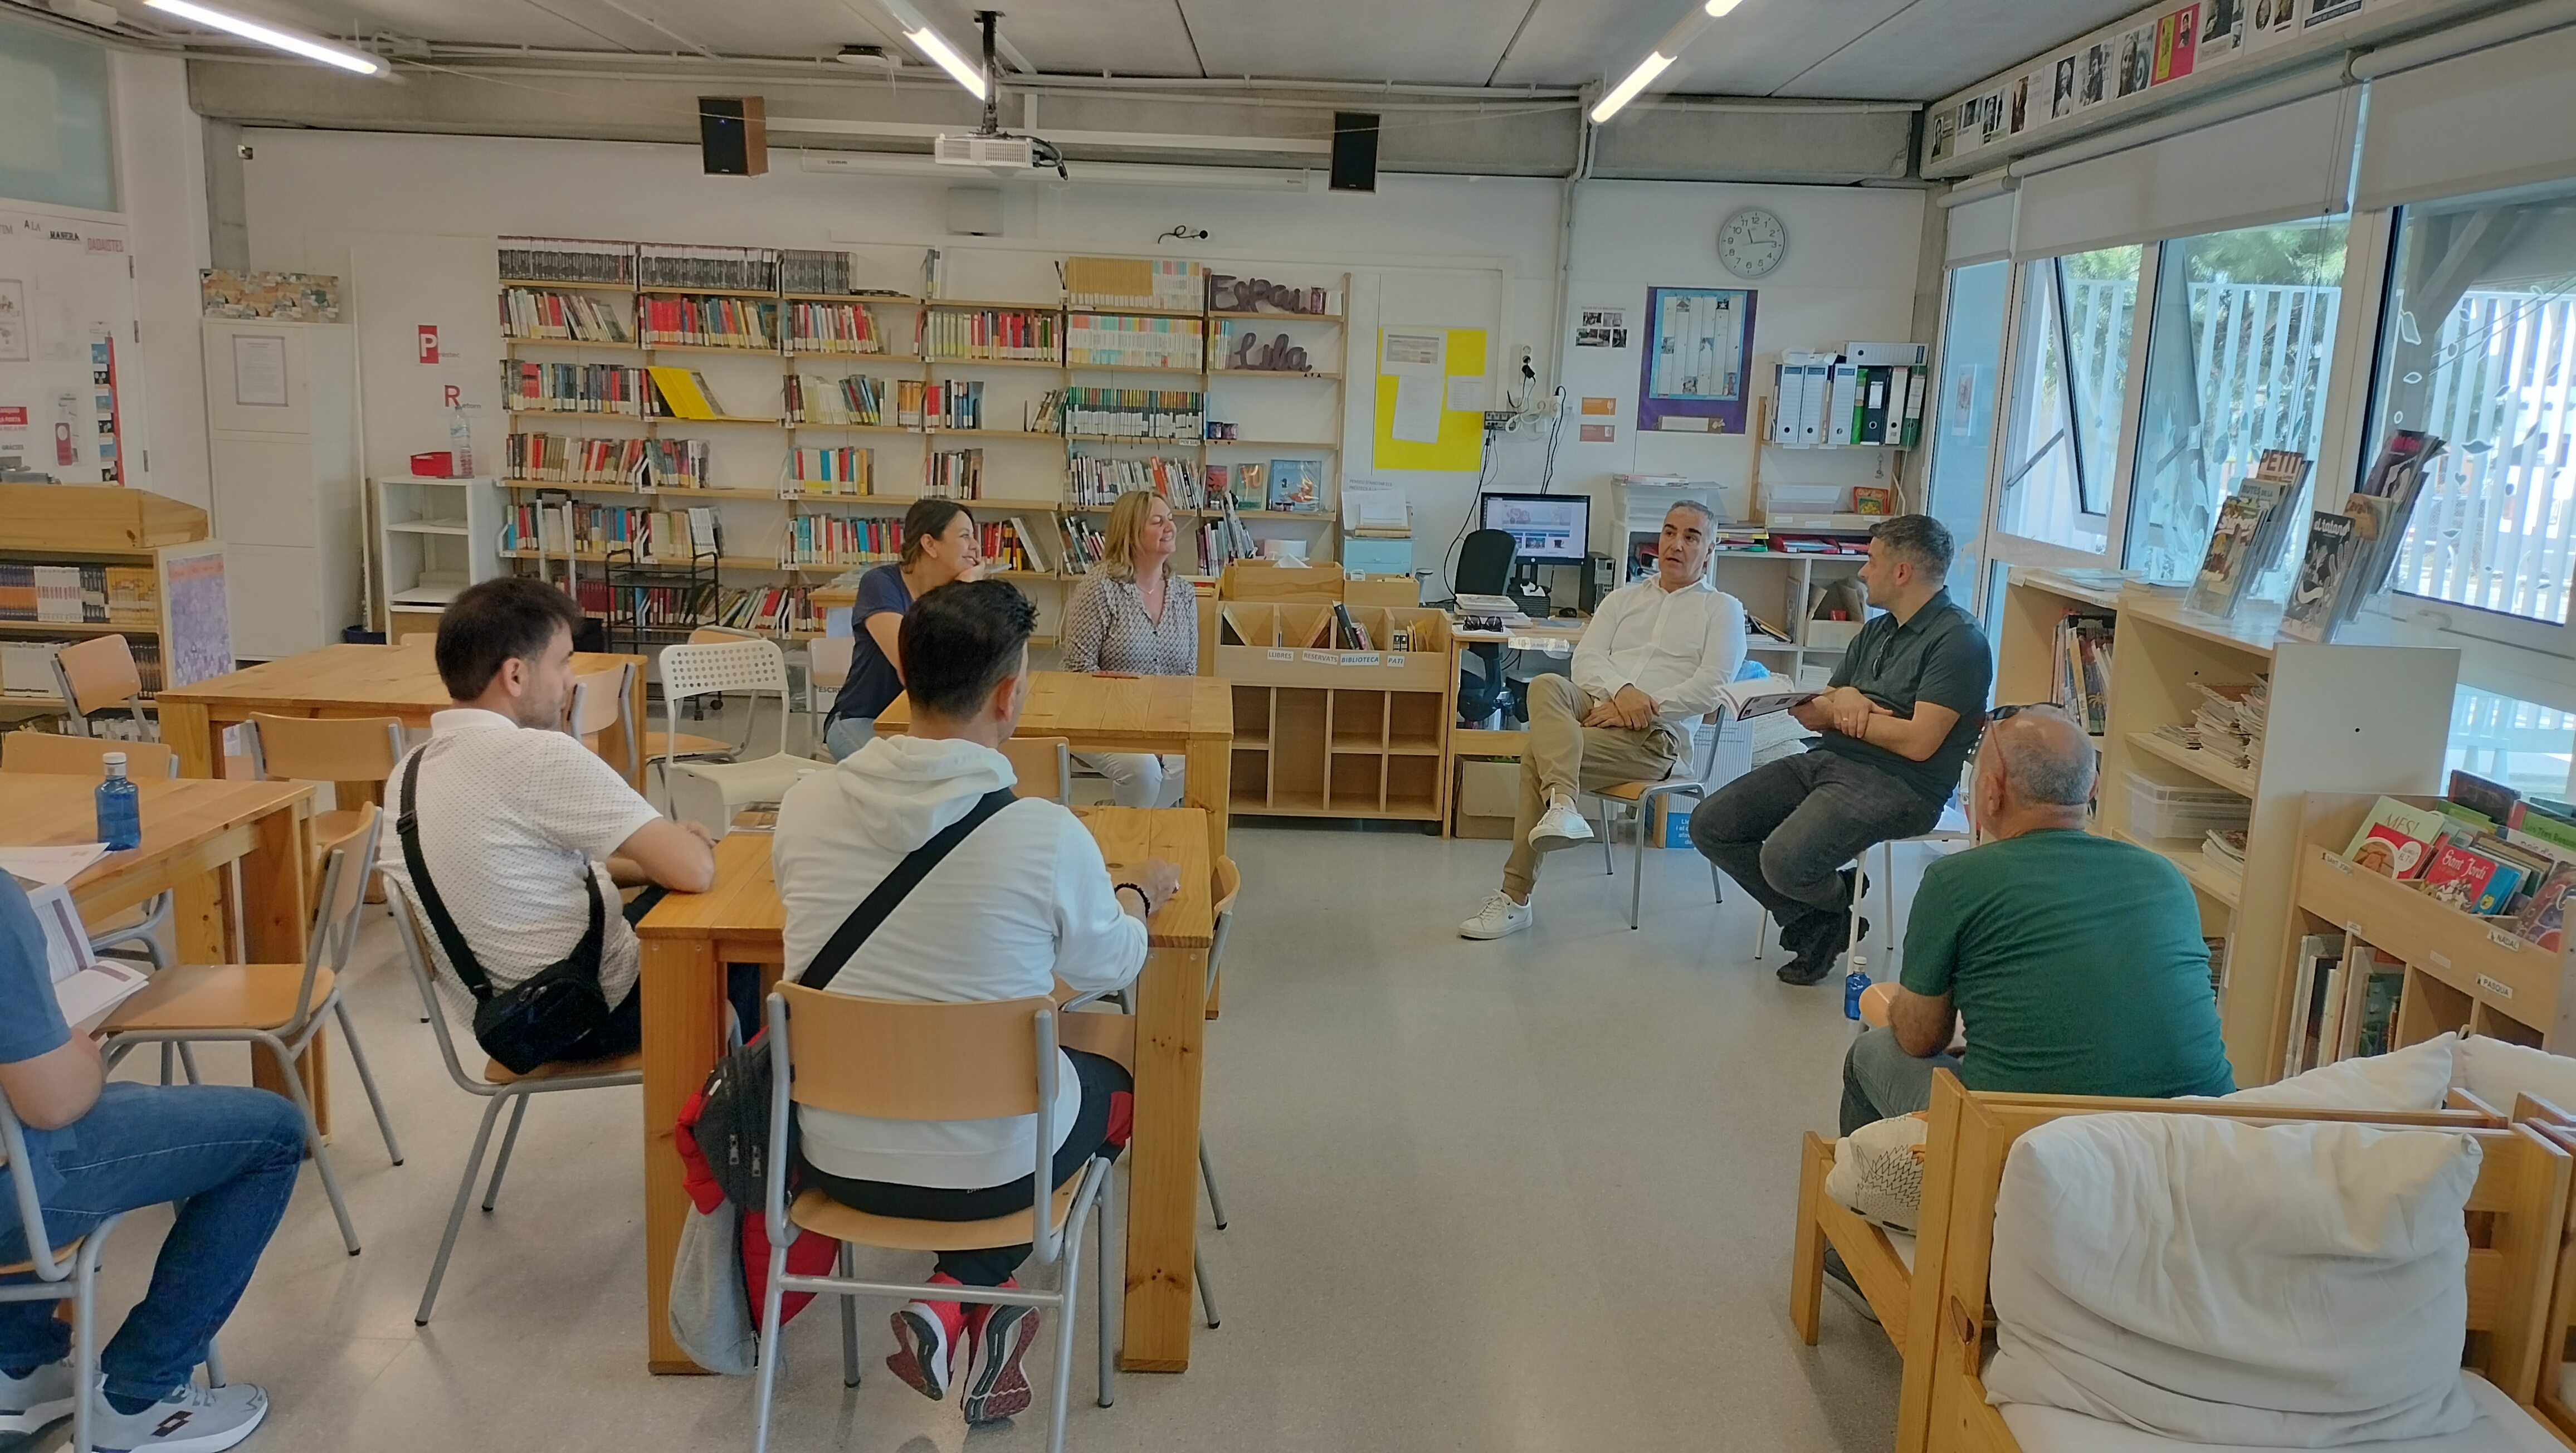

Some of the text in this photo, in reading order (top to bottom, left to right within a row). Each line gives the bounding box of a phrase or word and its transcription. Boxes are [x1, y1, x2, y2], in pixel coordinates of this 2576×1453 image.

[24, 220, 30, 229] A
[31, 221, 41, 232] LA
[50, 231, 80, 241] MANERA
[1733, 226, 1742, 235] 10
[1210, 275, 1311, 314] Espai
[1234, 333, 1313, 372] Lila
[1304, 652, 1338, 662] RESERVATS
[2442, 849, 2465, 870] Sant
[2461, 857, 2489, 880] Jordi
[2496, 934, 2518, 949] NADAL
[2483, 978, 2509, 996] PASQUA
